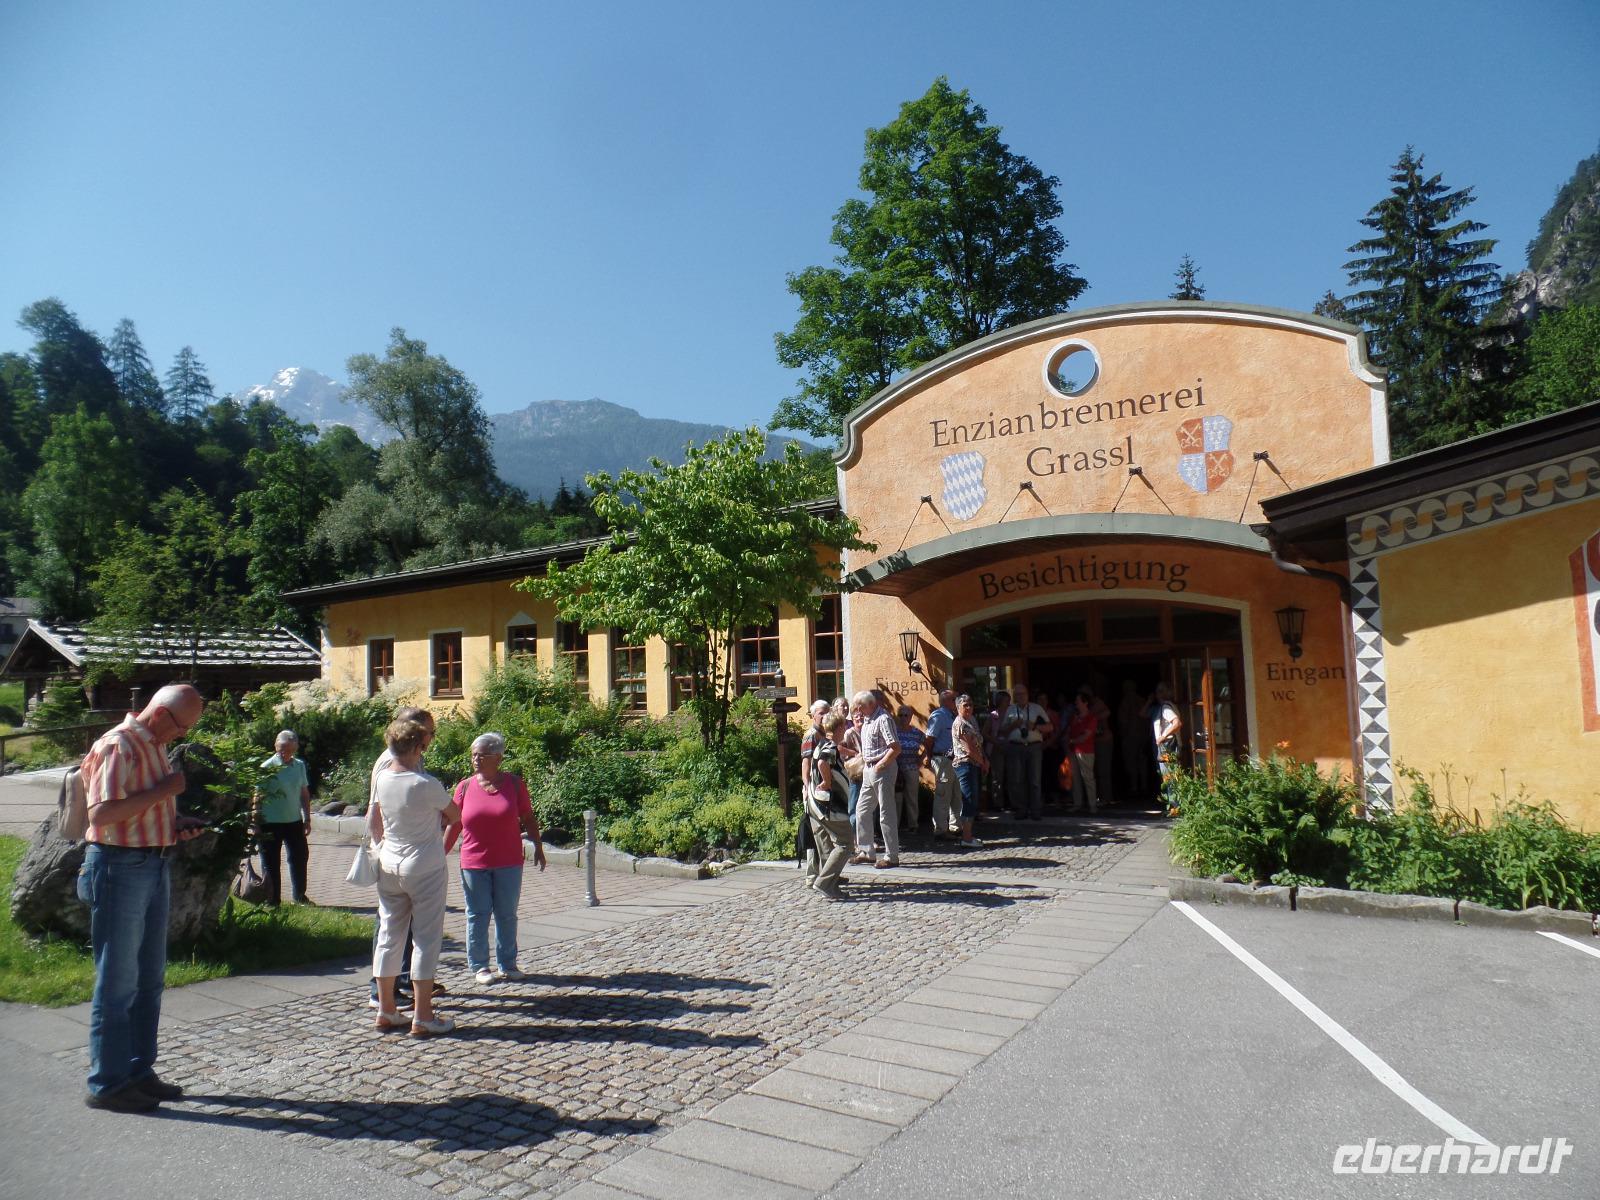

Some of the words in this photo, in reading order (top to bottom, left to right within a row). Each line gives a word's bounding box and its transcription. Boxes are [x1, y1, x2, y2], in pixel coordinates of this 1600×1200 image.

[1026, 436, 1135, 476] Grassl
[979, 555, 1189, 600] Besichtigung
[875, 678, 938, 696] Eingang
[1266, 663, 1346, 686] Eingan
